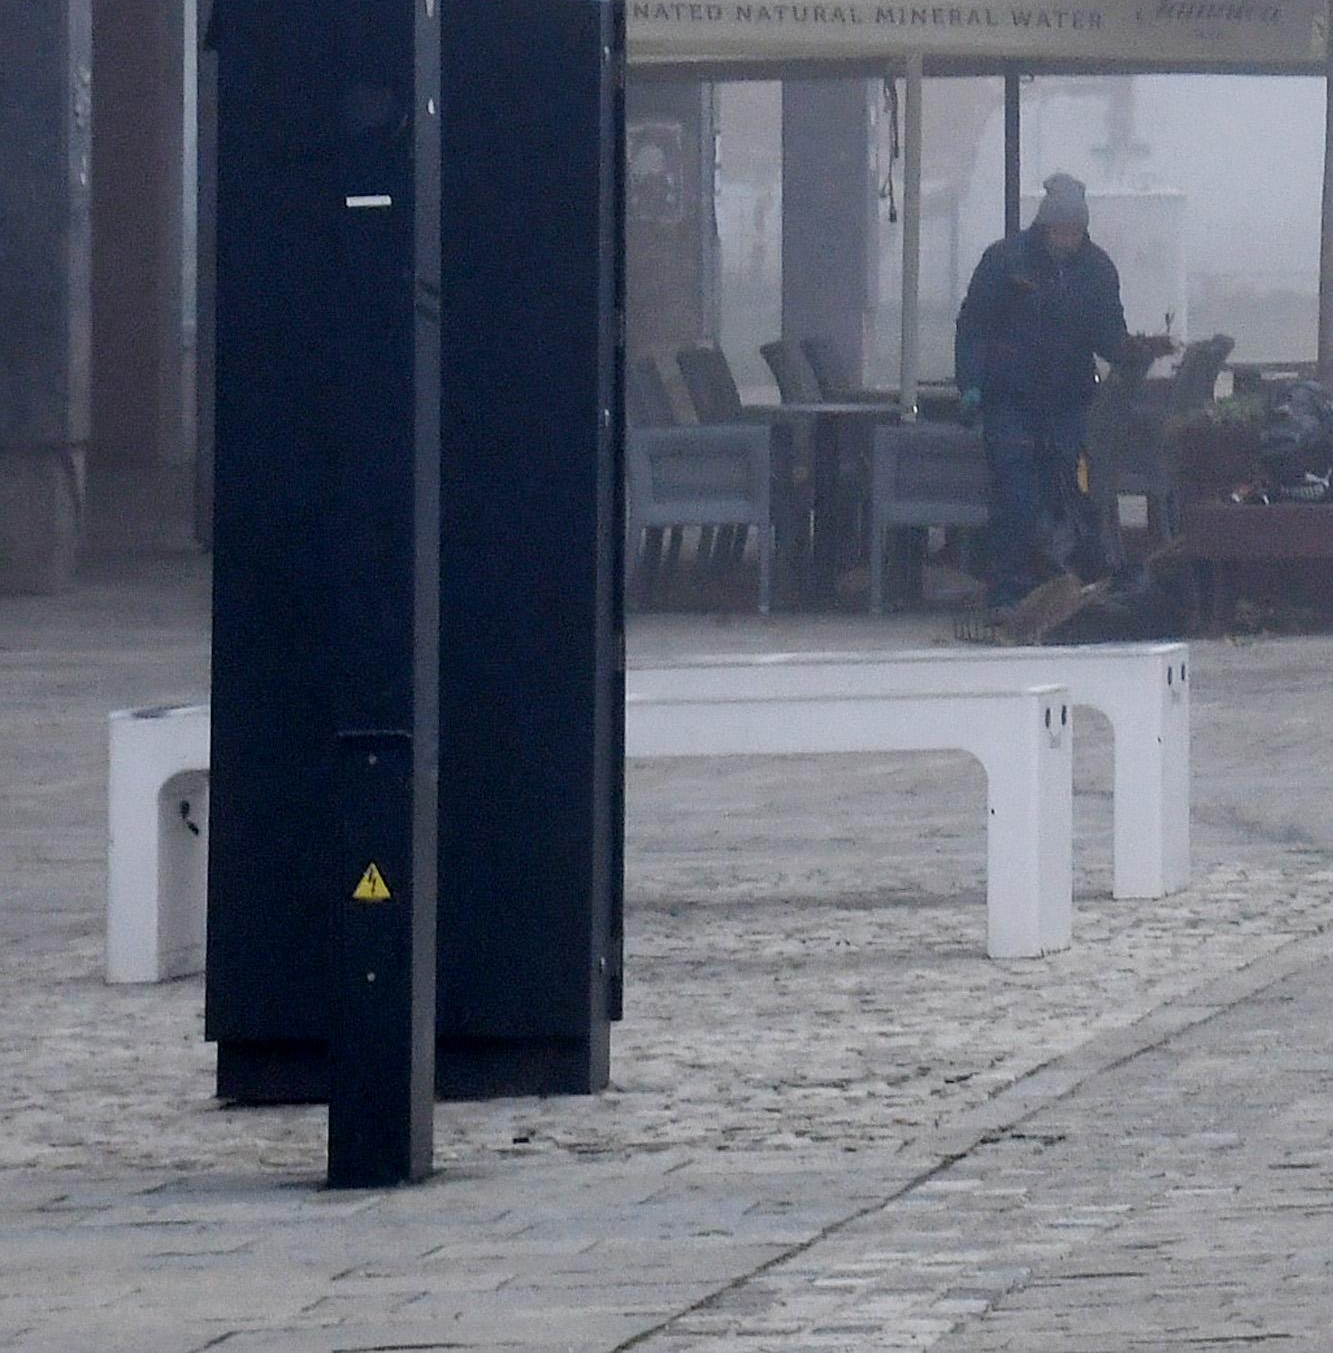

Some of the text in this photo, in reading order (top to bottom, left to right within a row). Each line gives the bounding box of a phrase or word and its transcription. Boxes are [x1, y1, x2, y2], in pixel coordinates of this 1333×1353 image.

[736, 4, 861, 24] NATURAL
[875, 7, 999, 27] MINERAL
[1011, 9, 1103, 29] WATER
